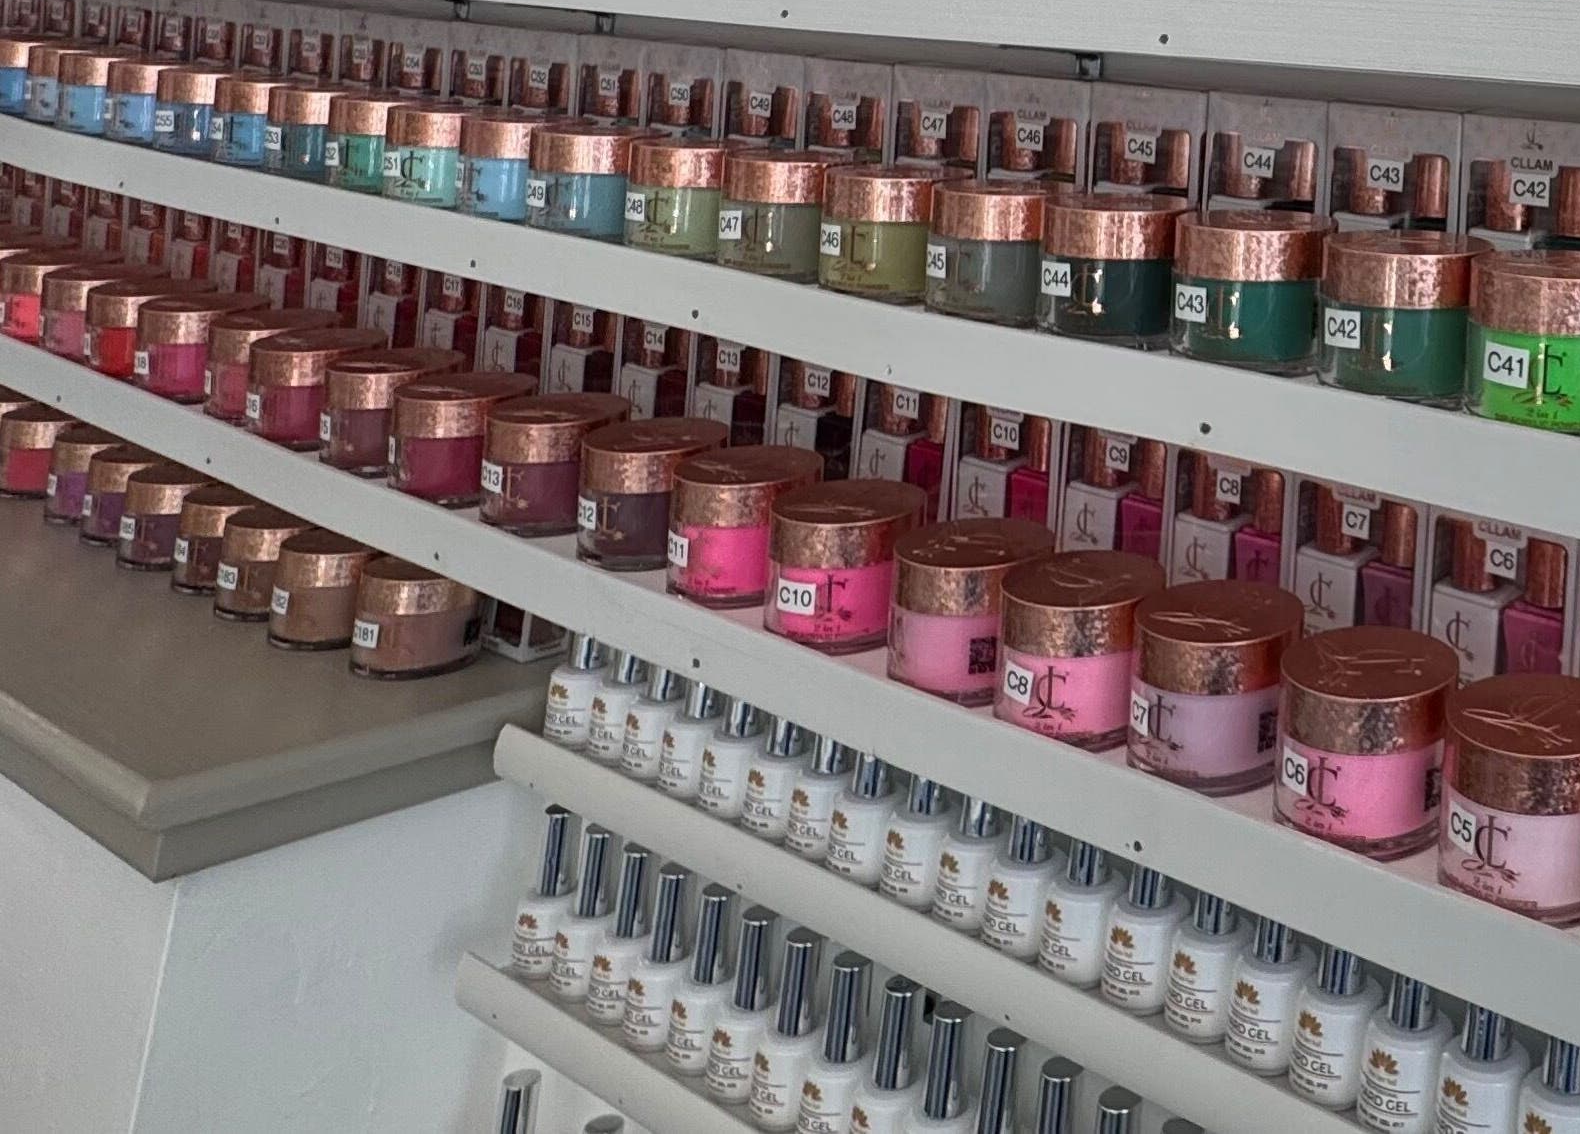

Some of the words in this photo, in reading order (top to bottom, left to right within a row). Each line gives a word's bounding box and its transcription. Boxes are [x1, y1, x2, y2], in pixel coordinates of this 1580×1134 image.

[750, 95, 770, 111] C49
[833, 109, 854, 124] C48
[922, 116, 945, 132] C47
[1018, 127, 1041, 145] C46
[1128, 139, 1154, 156] C45
[1245, 152, 1272, 170] C44
[1510, 157, 1553, 171] CLLAM
[1369, 165, 1400, 185] C43
[527, 184, 543, 201] C49
[1513, 179, 1546, 199] C42
[720, 216, 739, 232] C47
[821, 229, 839, 247] C46
[927, 253, 945, 270] C45
[1043, 269, 1068, 286] C44
[505, 294, 522, 310] C16
[1177, 294, 1204, 313] C43
[574, 311, 592, 327] C15
[1328, 317, 1357, 339] C42
[645, 331, 663, 345] C14
[718, 348, 738, 366] C13
[1488, 352, 1524, 378] C41
[806, 373, 829, 390] C12
[895, 394, 918, 412] C11
[993, 425, 1017, 444] C10
[1108, 446, 1128, 465] C9
[482, 467, 500, 486] C13
[1219, 478, 1240, 496] C8
[1345, 510, 1367, 529] C7
[1478, 521, 1522, 540] CLLAM
[668, 539, 685, 557] C11
[1490, 549, 1515, 569] C6
[779, 586, 812, 607] C10
[1006, 672, 1029, 696] C8
[1132, 701, 1147, 723] C7
[1285, 762, 1306, 787] C6
[1451, 811, 1473, 843] C5
[1248, 1028, 1271, 1041] GEL
[1310, 1062, 1334, 1075] GEL
[1387, 1099, 1411, 1113] GEL
